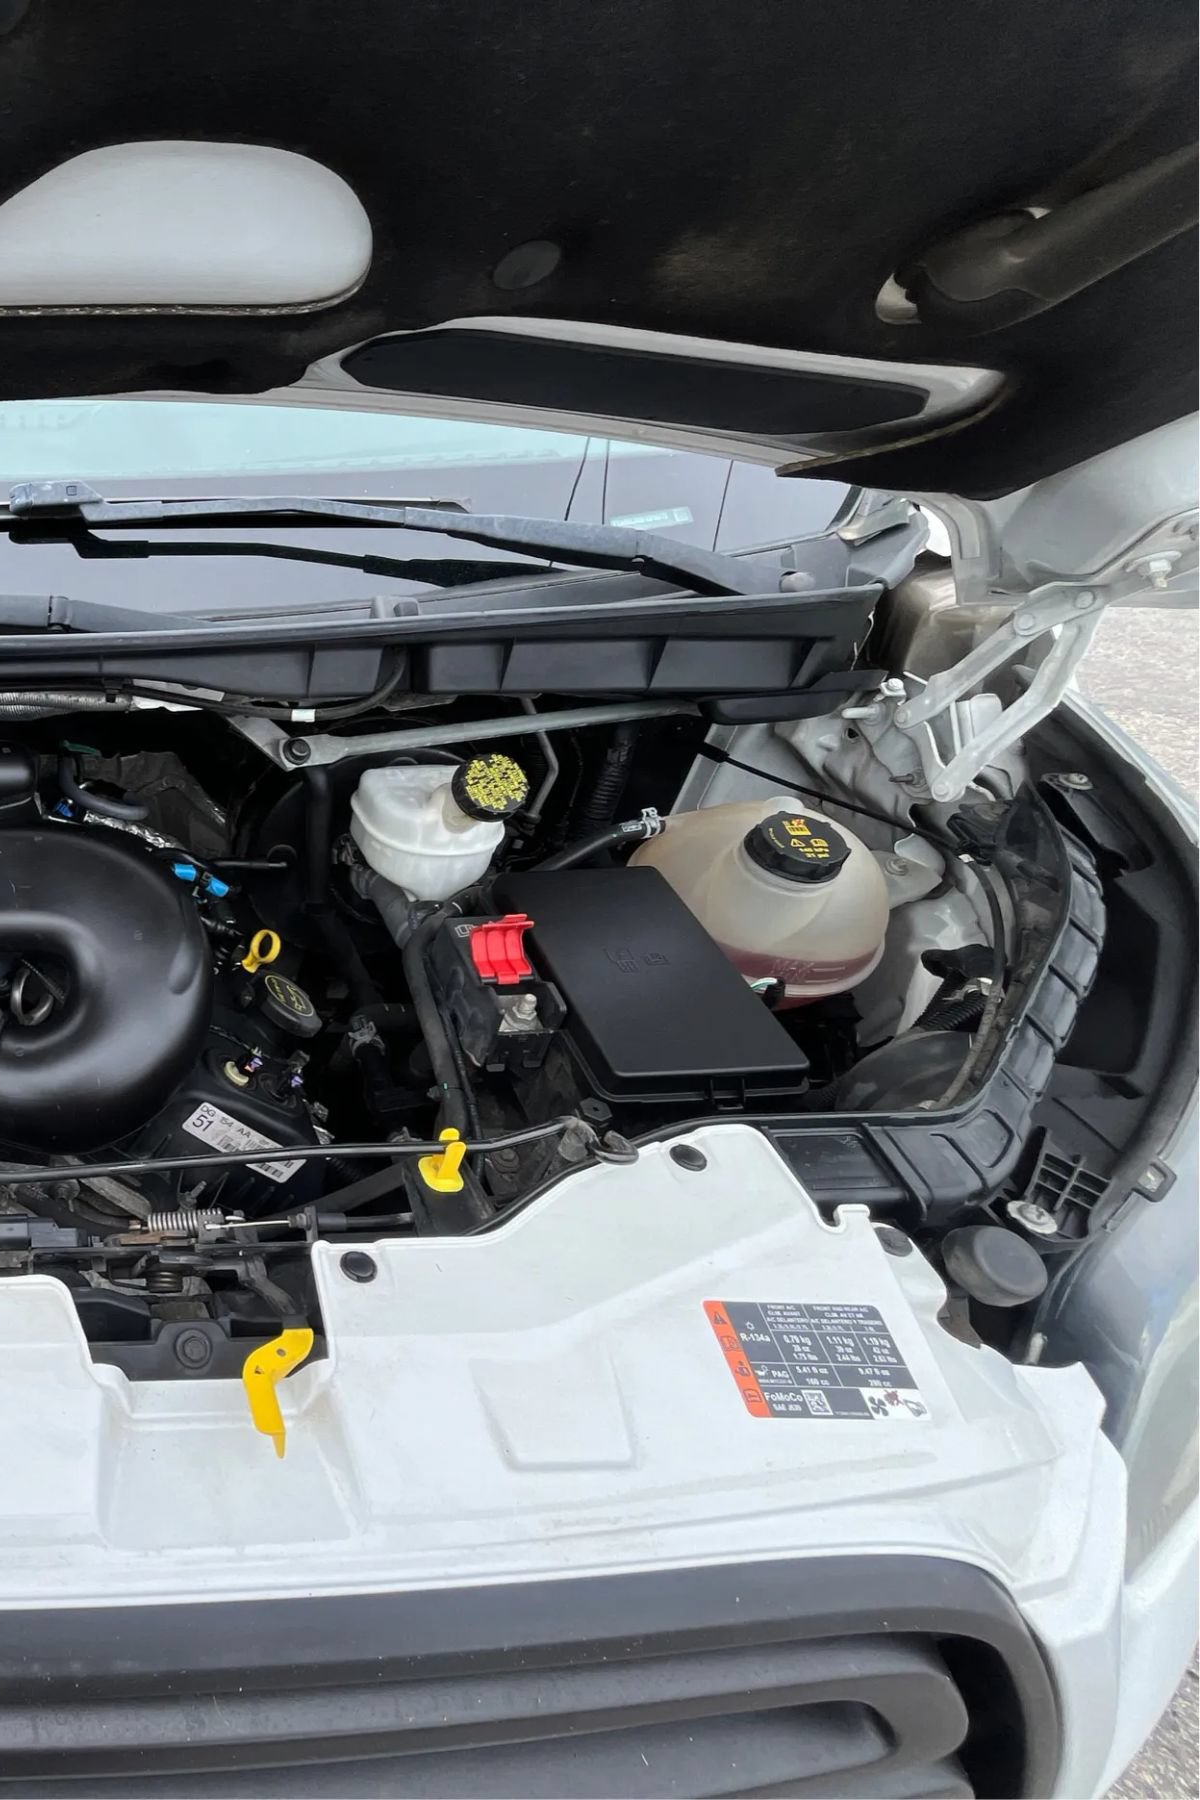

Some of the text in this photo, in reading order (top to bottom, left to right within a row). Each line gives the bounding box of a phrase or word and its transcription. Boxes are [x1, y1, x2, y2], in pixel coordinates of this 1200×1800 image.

[200, 1104, 216, 1118] DG
[192, 1114, 215, 1133] 51
[739, 1332, 771, 1342] R-134a
[799, 1335, 812, 1346] kg
[841, 1336, 855, 1347] kg
[878, 1337, 891, 1348] kg
[771, 1370, 789, 1378] PAG
[764, 1391, 804, 1402] FoMoCo
